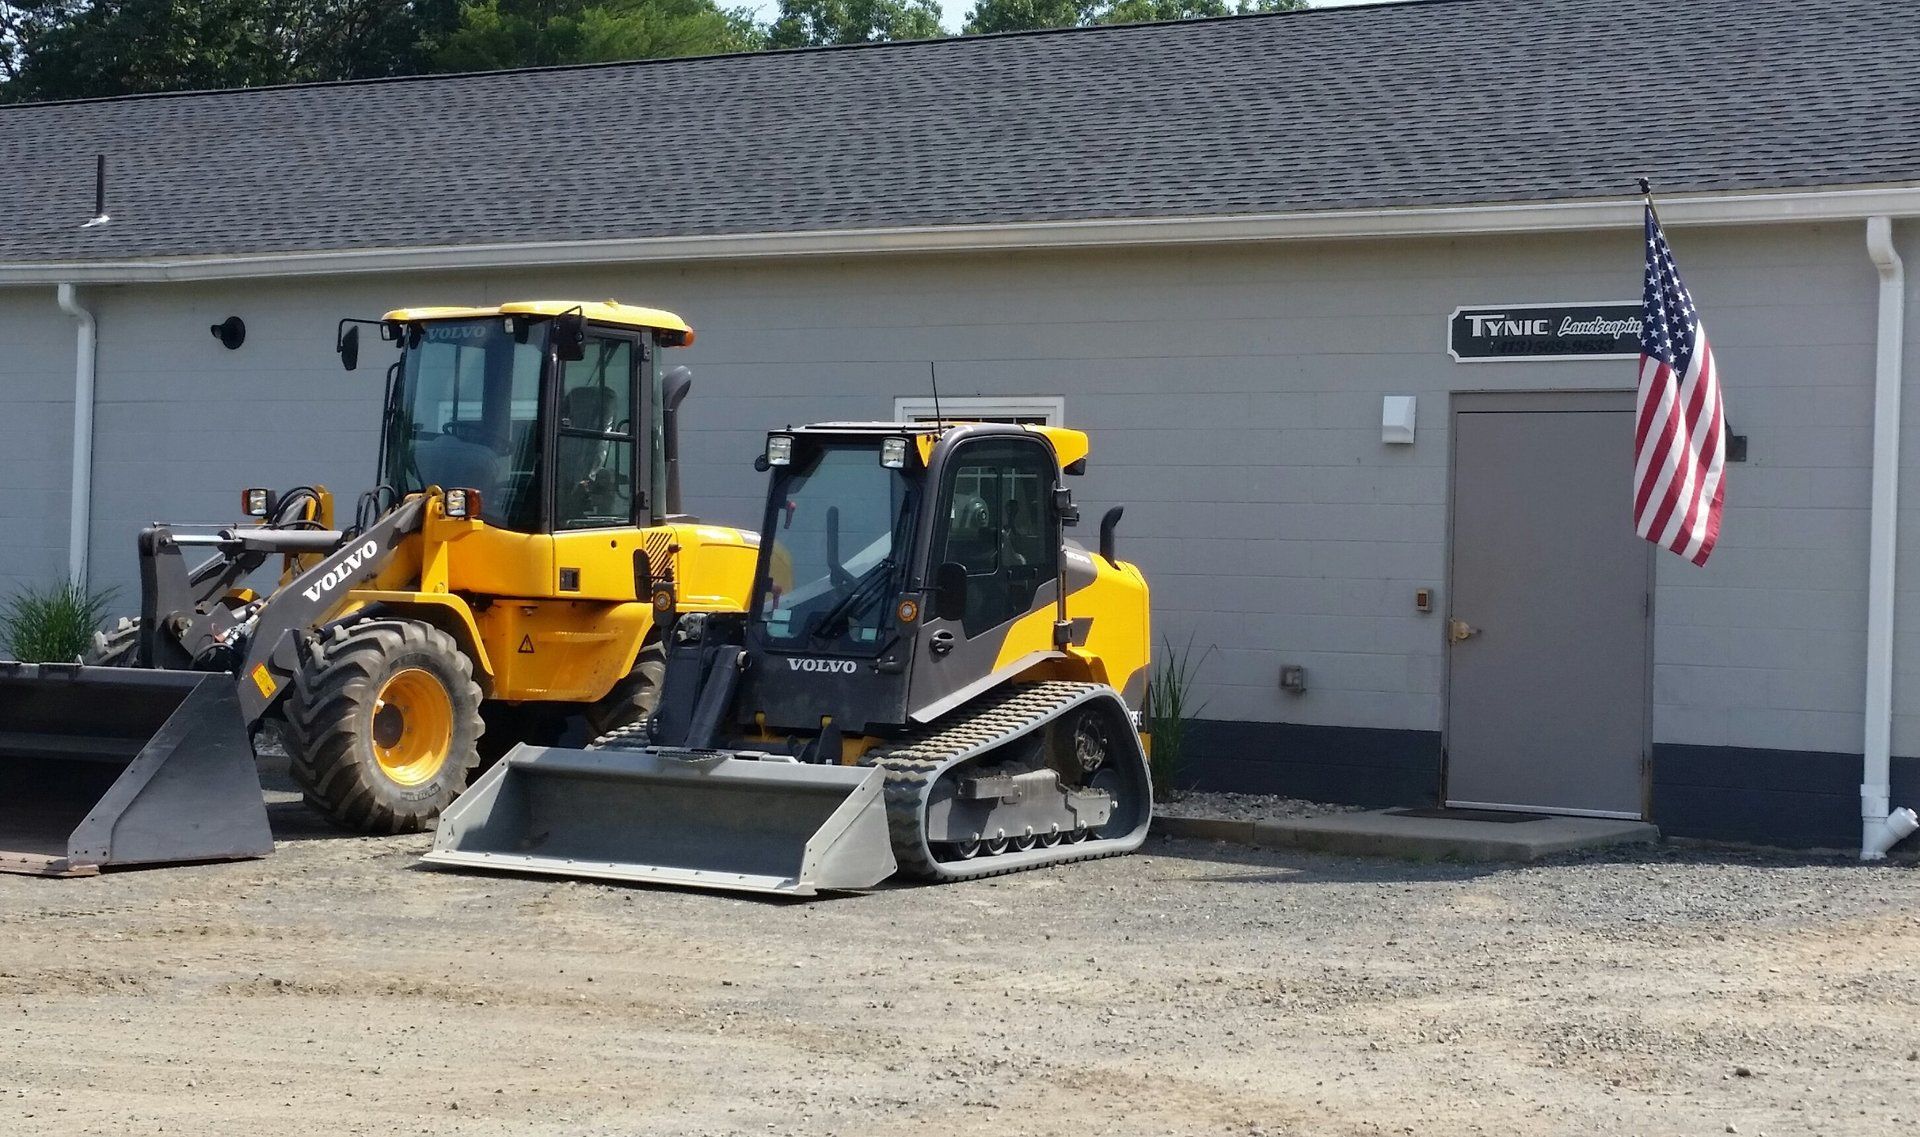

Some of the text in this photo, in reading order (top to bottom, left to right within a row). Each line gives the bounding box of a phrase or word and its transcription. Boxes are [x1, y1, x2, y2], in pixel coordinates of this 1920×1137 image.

[428, 326, 486, 340] VOLVO
[1465, 314, 1550, 338] TYNIC
[302, 540, 378, 602] VOLVO
[786, 658, 857, 674] VOLVO
